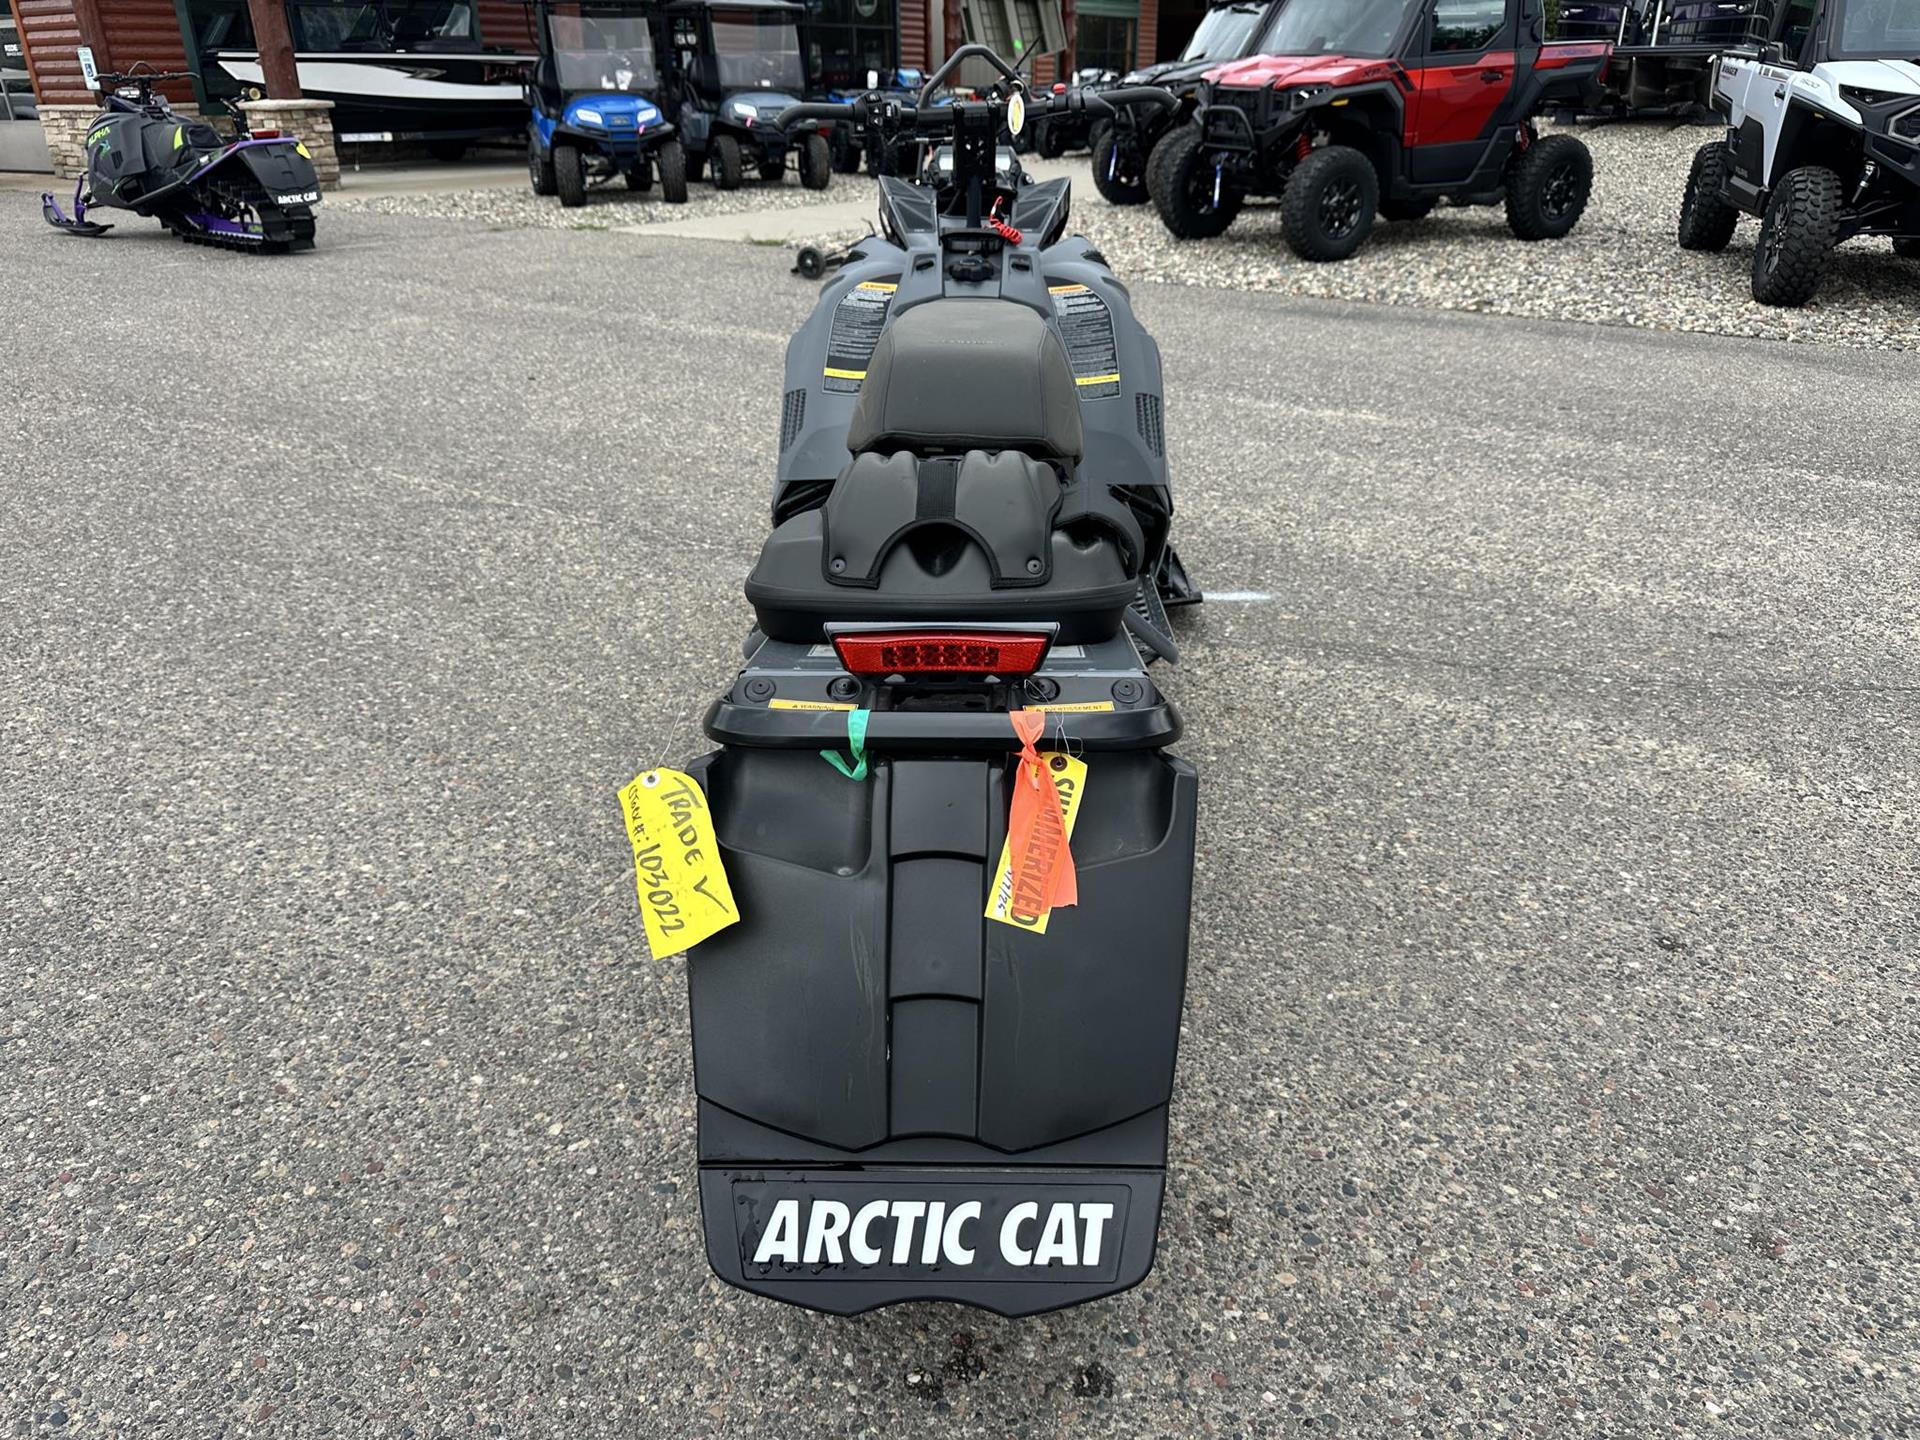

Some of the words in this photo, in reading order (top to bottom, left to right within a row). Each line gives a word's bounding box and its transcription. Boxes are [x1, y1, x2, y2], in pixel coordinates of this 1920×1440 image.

[277, 193, 303, 204] ARCTIC
[660, 776, 705, 867] TRADE
[636, 843, 686, 938] 103022
[753, 1199, 982, 1266] ARCTIC
[999, 1201, 1114, 1267] CAT
